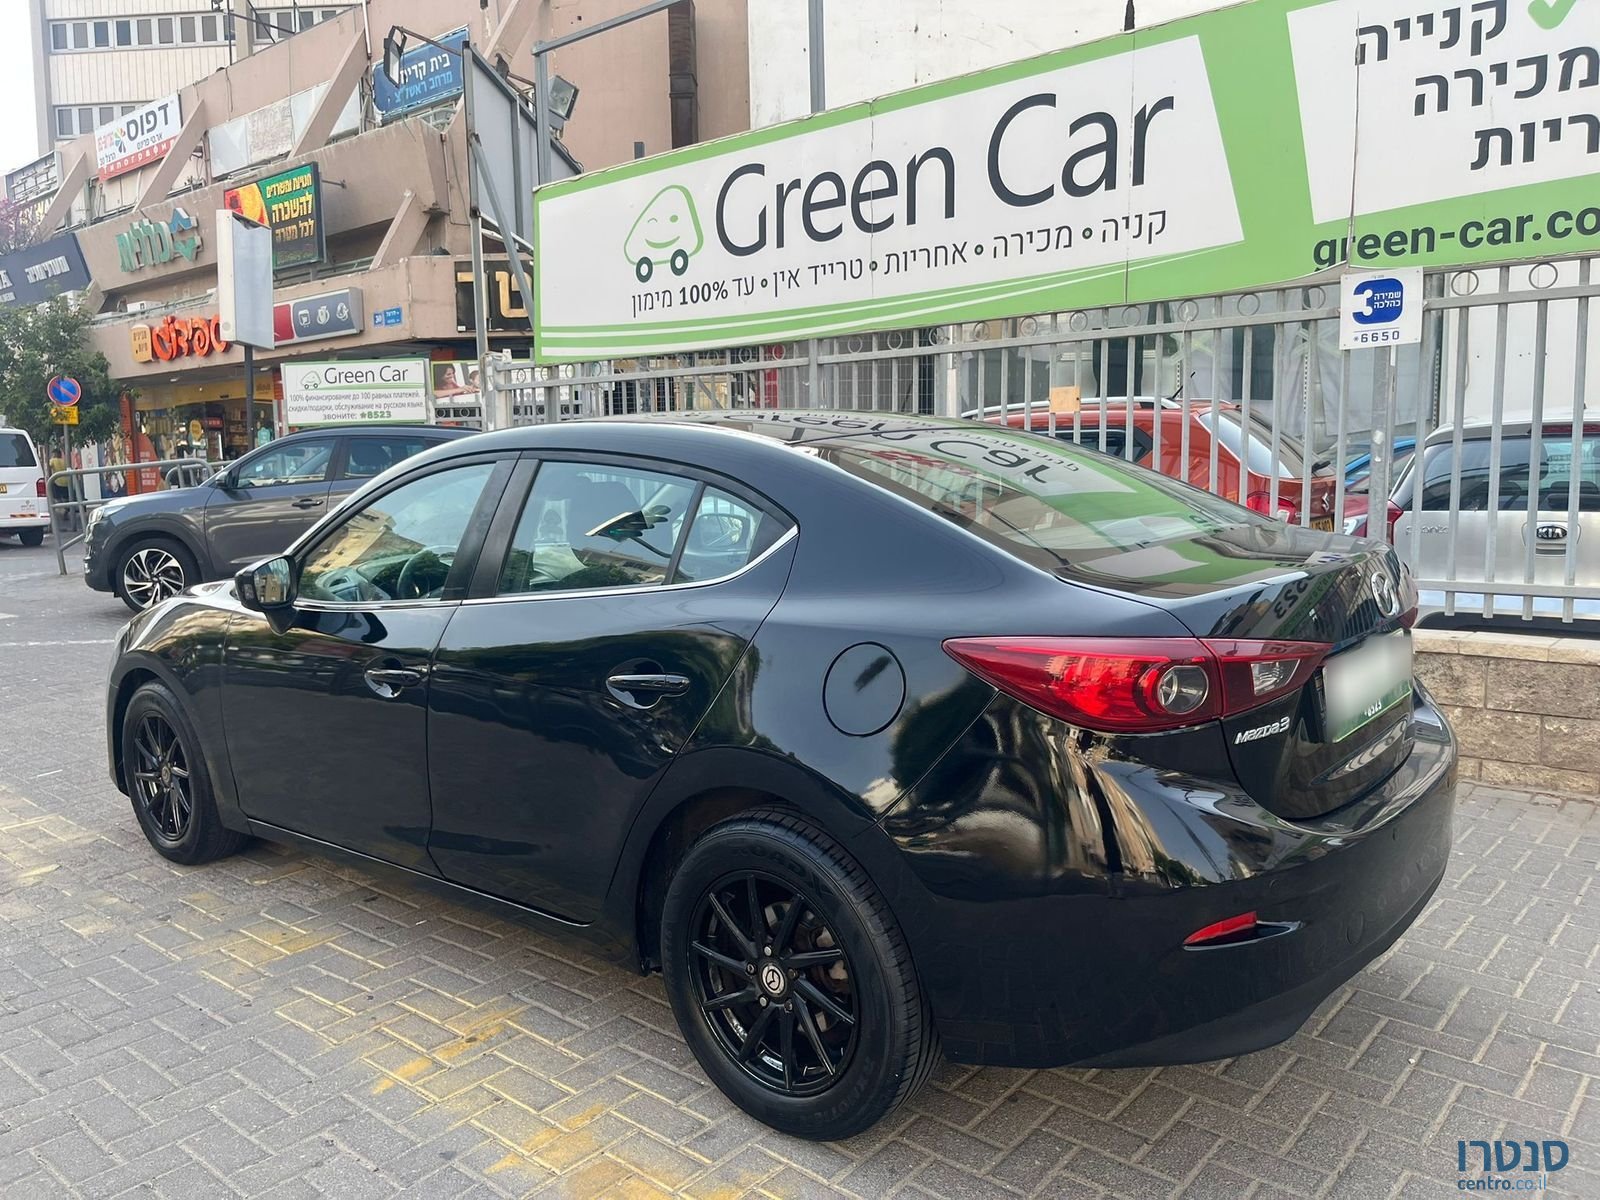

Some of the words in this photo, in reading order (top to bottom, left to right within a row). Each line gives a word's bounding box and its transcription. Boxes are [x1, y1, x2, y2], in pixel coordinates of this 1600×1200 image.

[1355, 0, 1507, 65] קנייה
[430, 53, 451, 73] בית
[428, 71, 453, 90] מרחב
[1414, 46, 1600, 117] מכירה
[126, 102, 169, 142] דפוס
[1470, 113, 1600, 171] ריות
[716, 147, 955, 257] Green
[988, 93, 1175, 207] Car
[272, 191, 313, 223] להשכרה
[298, 218, 314, 238] לכל
[994, 225, 1073, 259] מכירה
[1102, 211, 1166, 245] קניה
[808, 258, 863, 286] טרייד
[884, 242, 968, 275] אחריות
[679, 280, 729, 306] 100%
[731, 275, 755, 299] עד
[773, 268, 801, 299] אין
[1373, 291, 1402, 301] שמירה
[631, 289, 674, 318] מימון
[324, 367, 375, 385] Green
[379, 365, 409, 383] Car
[289, 393, 304, 402] 100%
[352, 392, 360, 401] до
[1536, 526, 1567, 539] KIA
